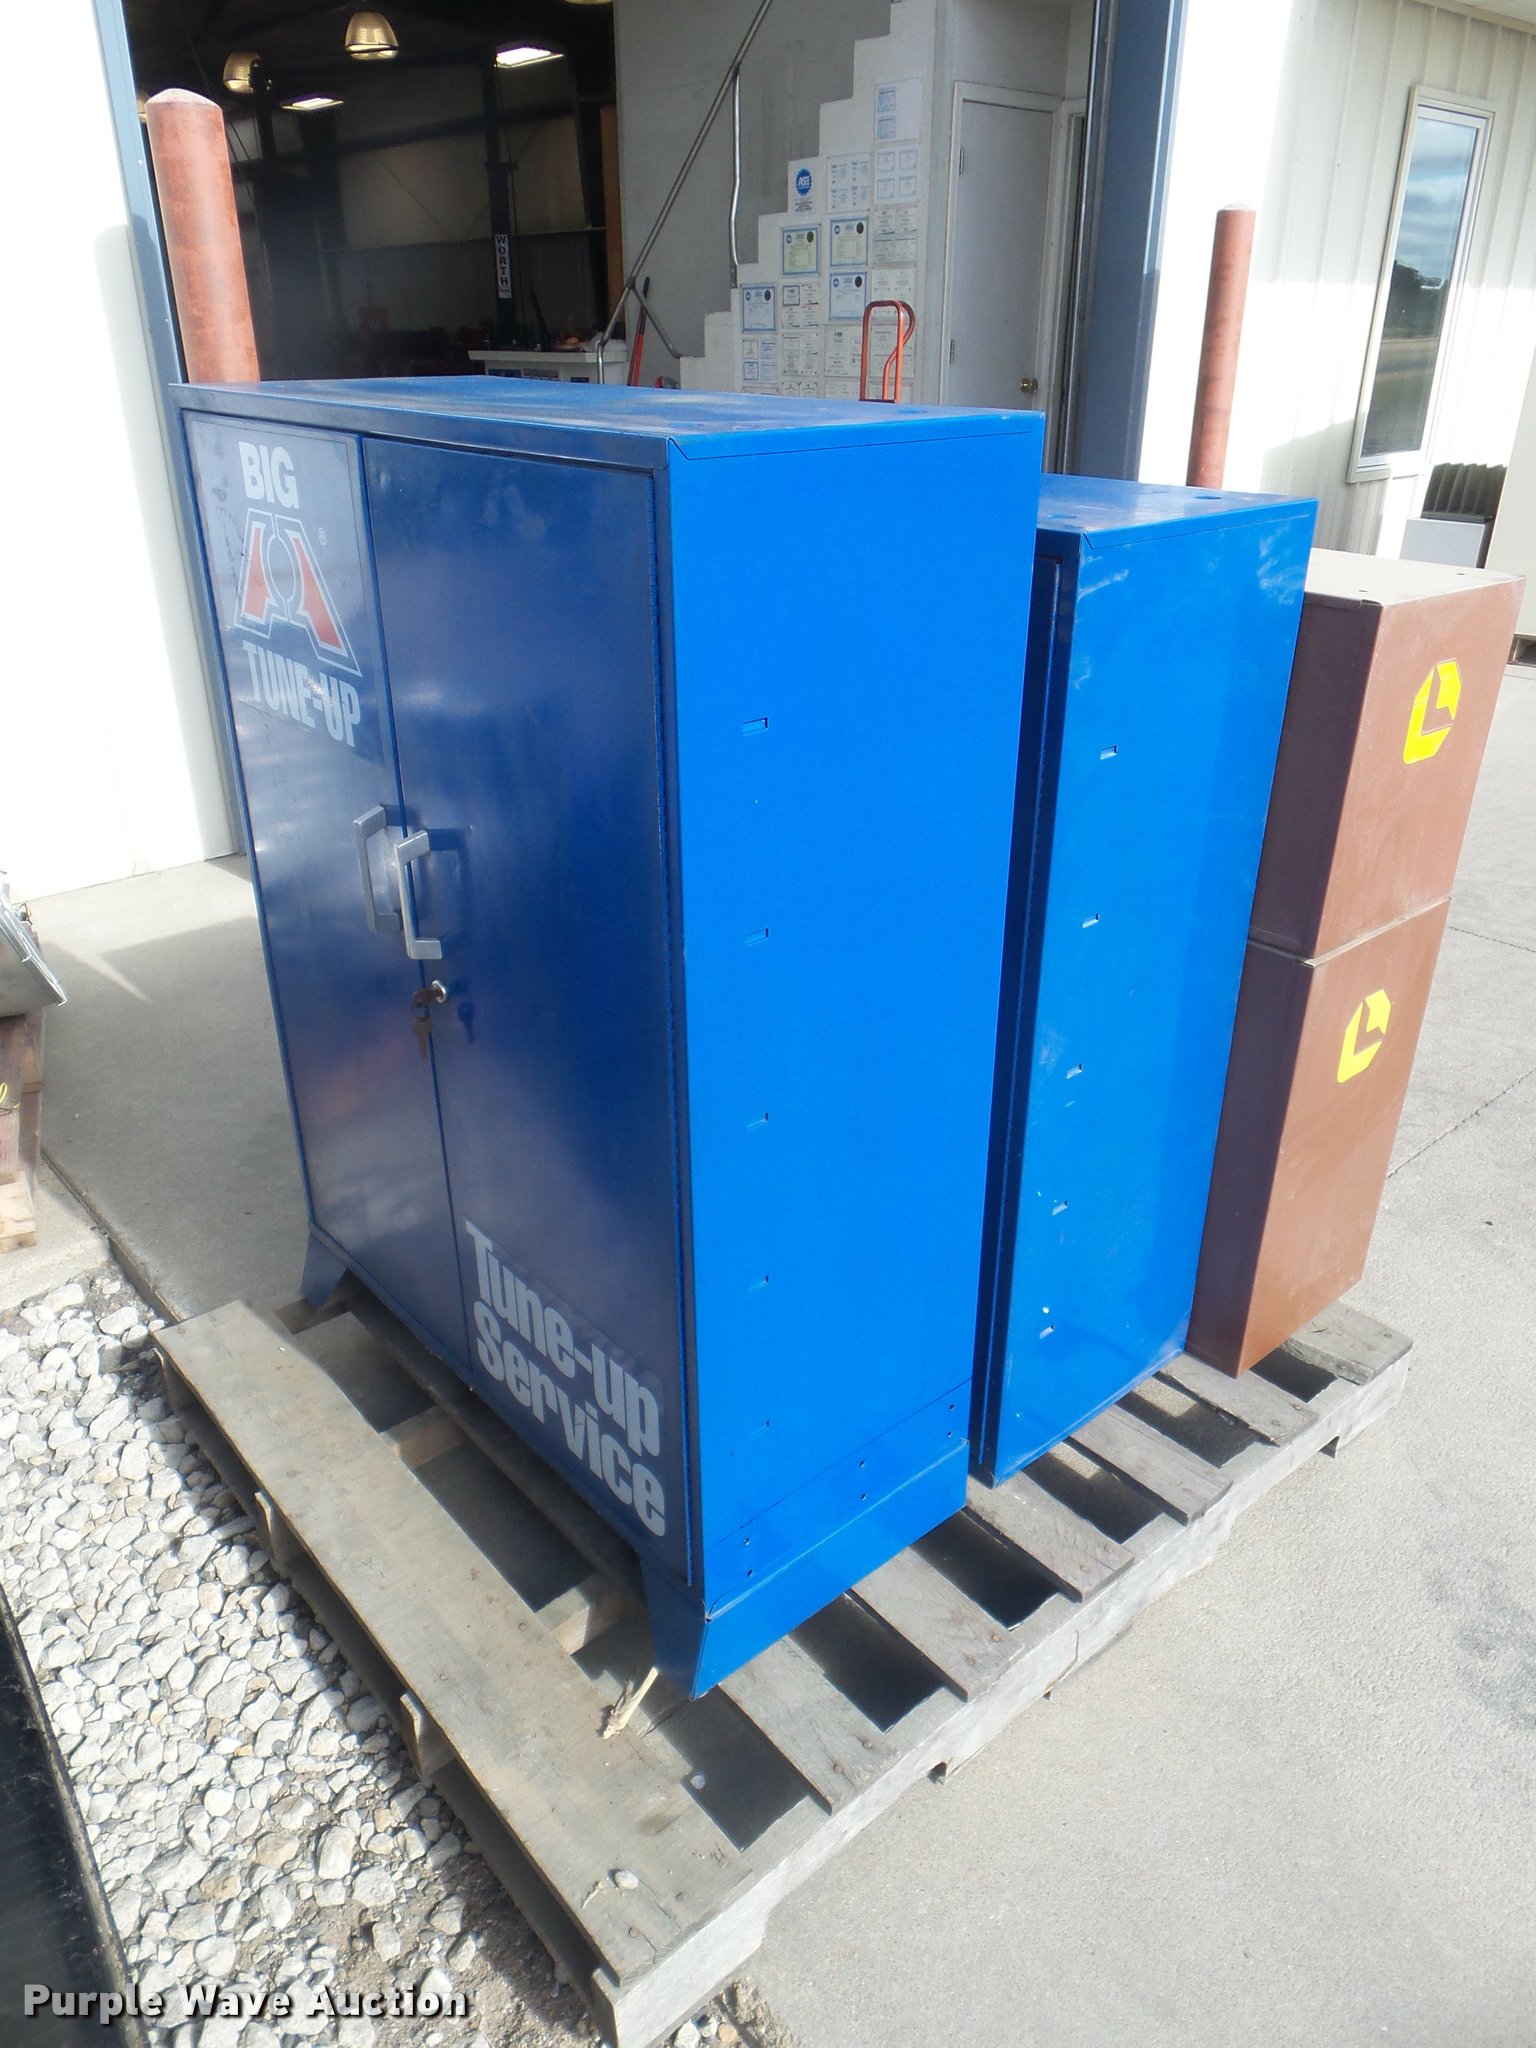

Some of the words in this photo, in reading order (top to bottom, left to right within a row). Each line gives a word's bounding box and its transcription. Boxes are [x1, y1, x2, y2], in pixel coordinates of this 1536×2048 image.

[496, 235, 508, 286] WORTH
[238, 441, 300, 509] BIG
[242, 639, 361, 748] TUNE-UP
[465, 1220, 660, 1457] Tune-up
[473, 1300, 666, 1537] Service
